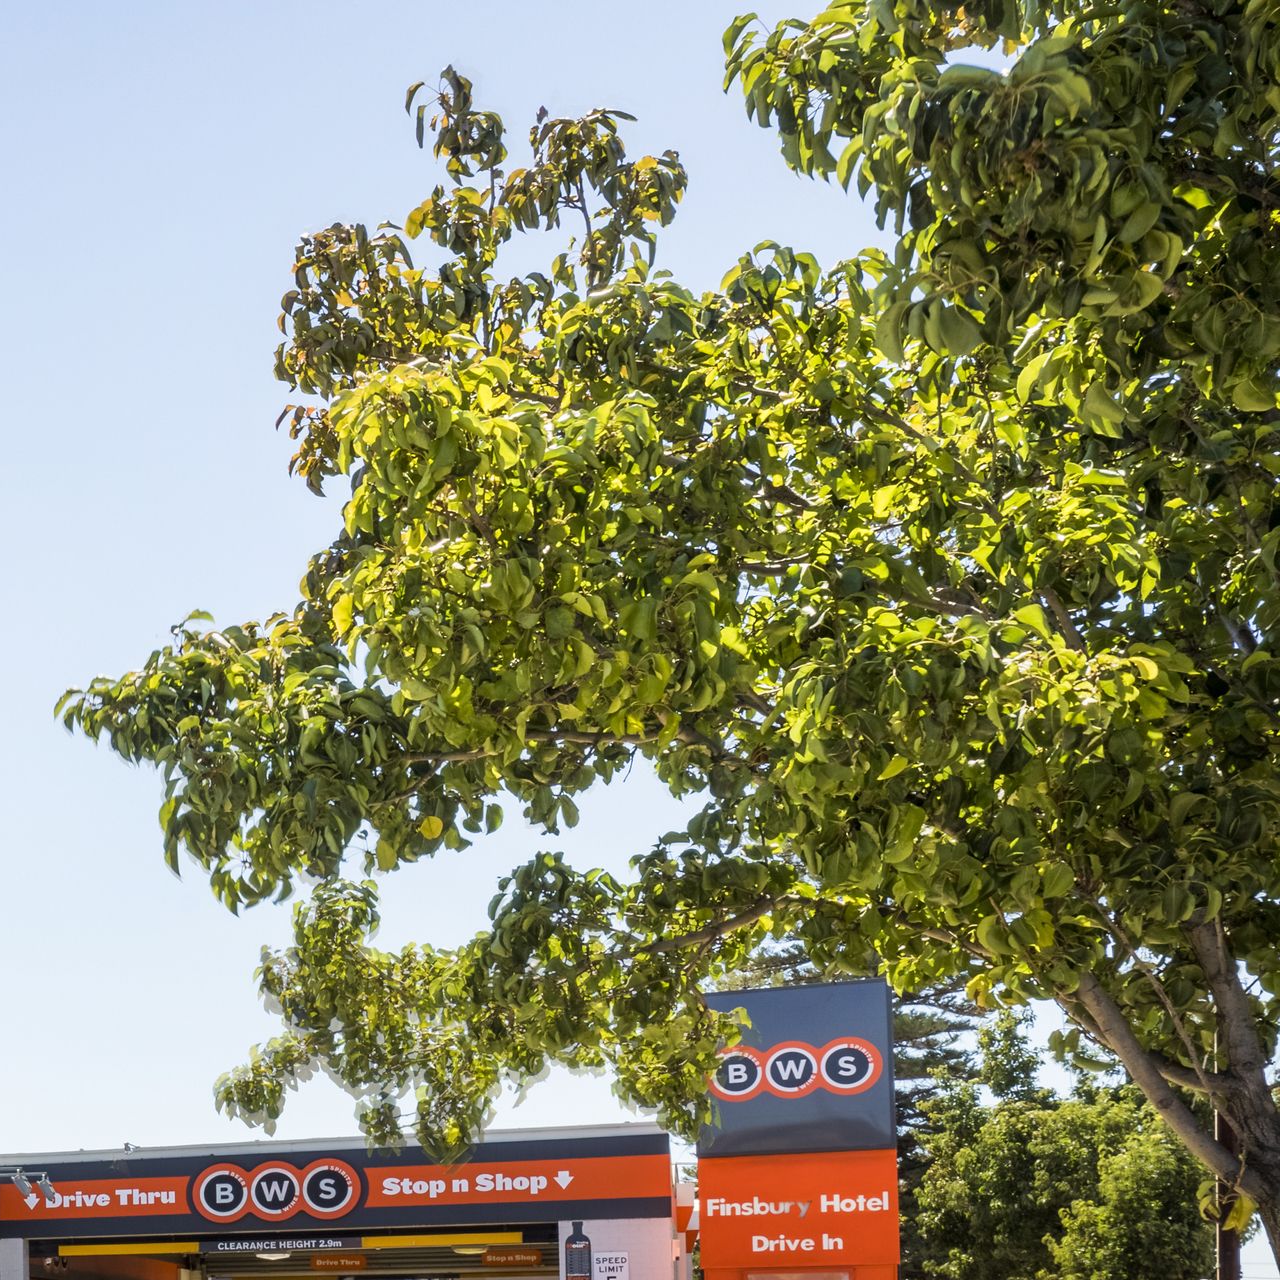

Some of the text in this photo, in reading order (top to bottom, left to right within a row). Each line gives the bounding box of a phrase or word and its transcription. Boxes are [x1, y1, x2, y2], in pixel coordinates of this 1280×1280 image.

[849, 1043, 874, 1063] SPIRITS
[799, 1074, 816, 1090] WINE
[230, 1171, 246, 1187] BEER
[330, 1165, 353, 1187] SPIRITS
[382, 1173, 547, 1198] Stop n Shop
[45, 1189, 176, 1208] Drive Thru
[282, 1196, 300, 1212] WINE
[707, 1191, 889, 1219] Finsbury Hotel
[217, 1239, 342, 1251] CLEARANCE HEIGHT 2.9m
[752, 1233, 843, 1252] Drive In
[486, 1255, 506, 1263] Stop
[515, 1254, 537, 1262] Shop
[595, 1257, 627, 1265] SPEED
